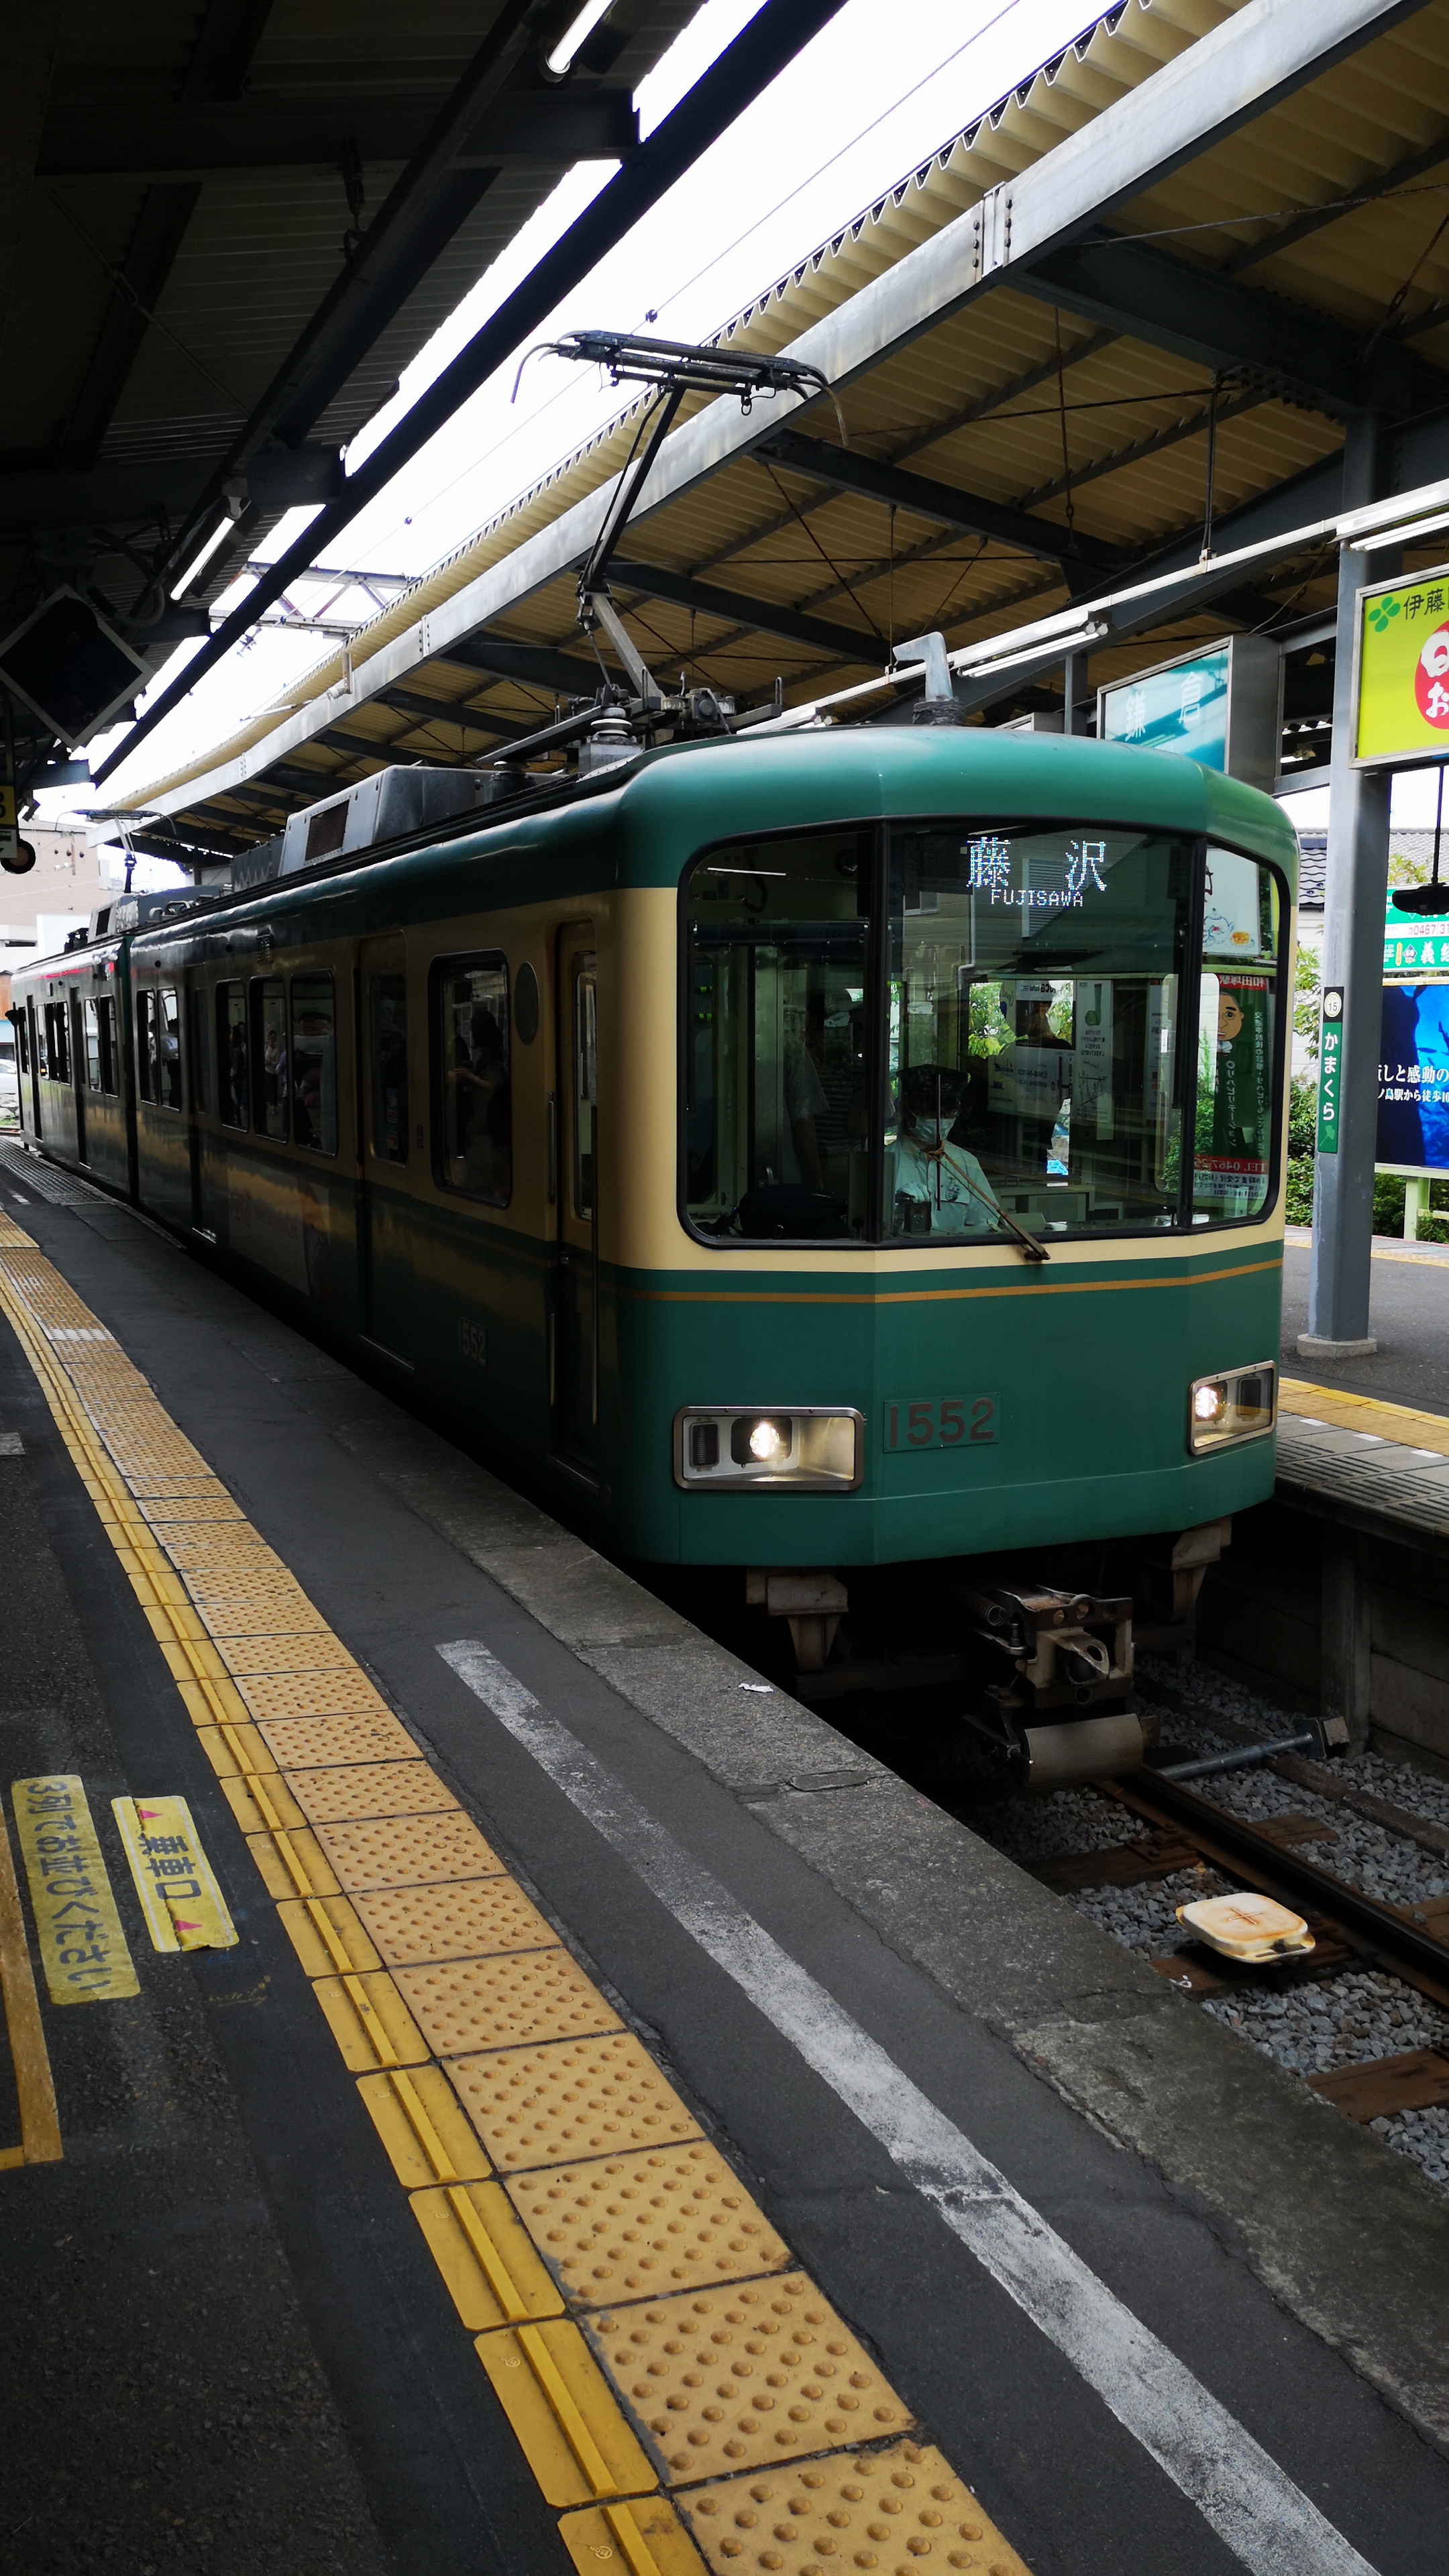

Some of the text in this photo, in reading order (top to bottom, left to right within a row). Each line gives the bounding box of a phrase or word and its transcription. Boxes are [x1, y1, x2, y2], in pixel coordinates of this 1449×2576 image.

[1403, 588, 1449, 620] 伊藤
[1124, 672, 1203, 741] 鎌倉
[966, 837, 1107, 892] 藤沢
[990, 889, 1083, 907] FUJISAWA
[1328, 1002, 1338, 1012] 15
[1323, 1032, 1338, 1121] かまくら
[890, 1397, 995, 1448] 1552
[27, 1782, 113, 1990] 3列でお並びください
[138, 1835, 202, 1900] 乗車口
